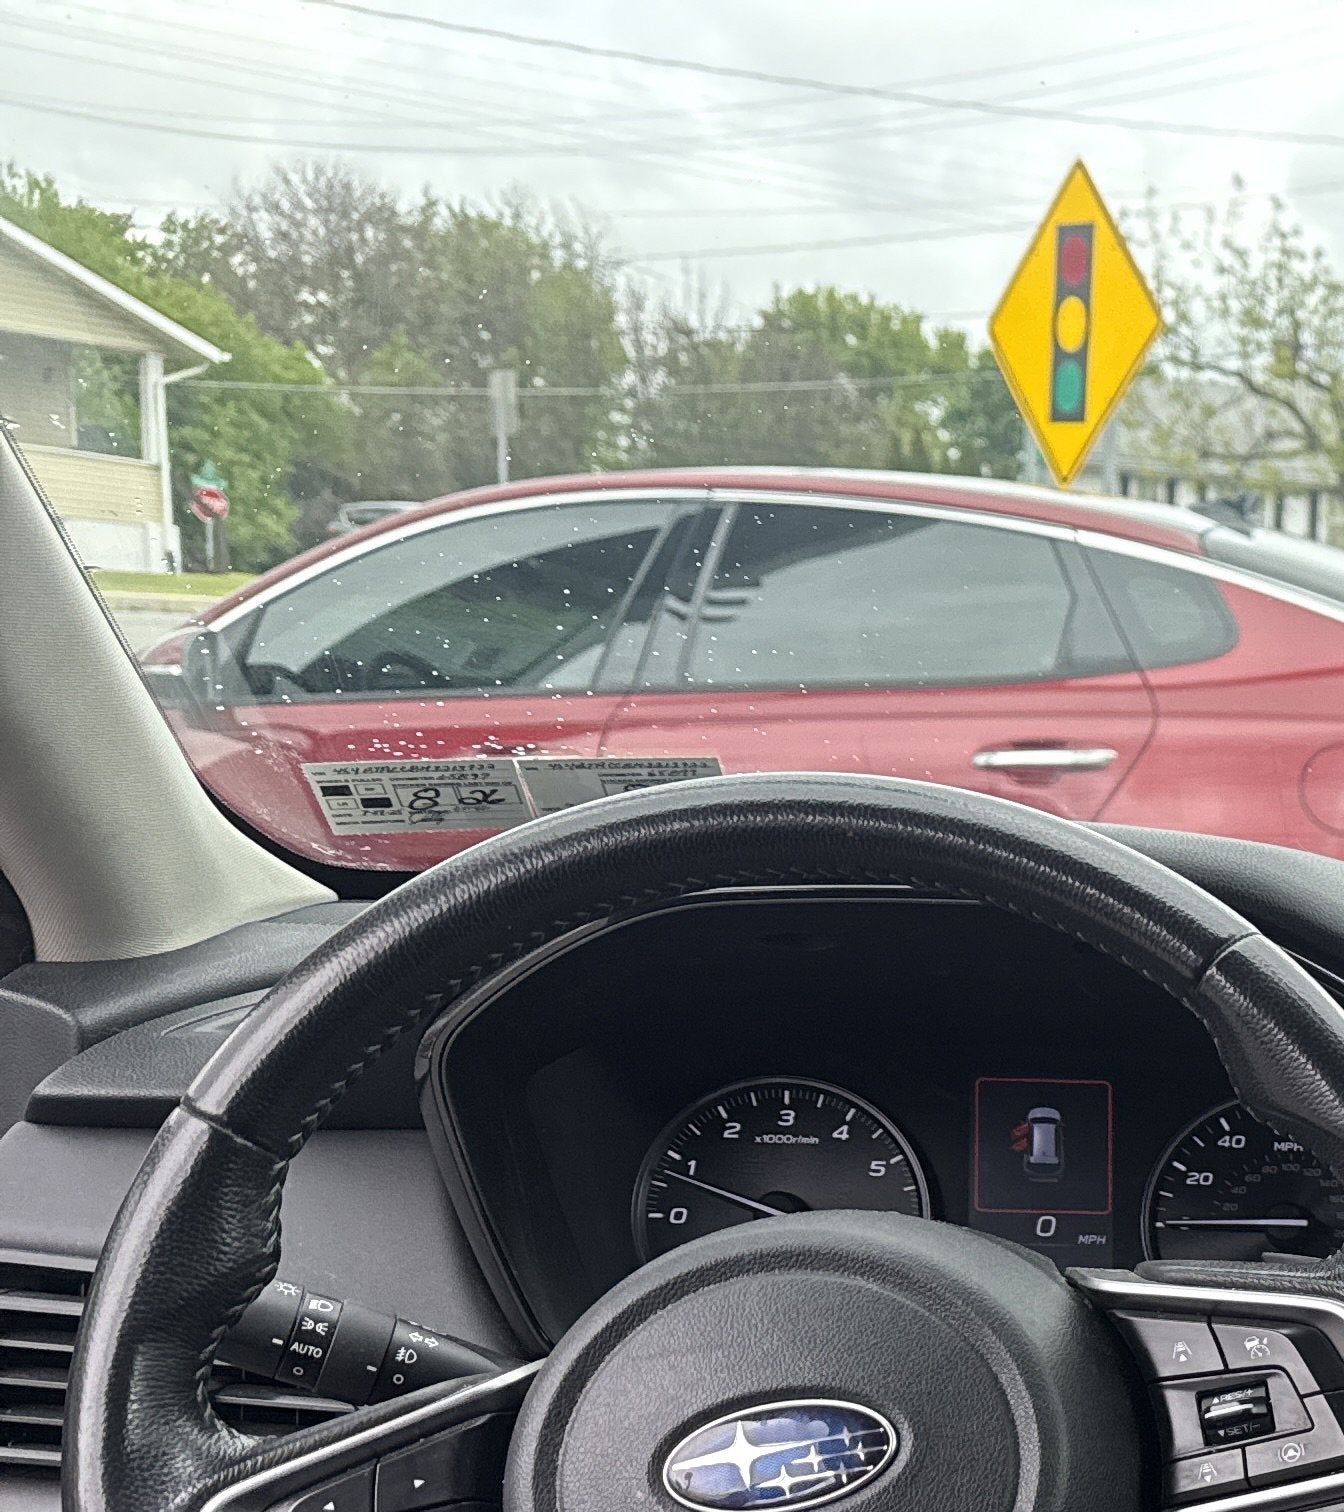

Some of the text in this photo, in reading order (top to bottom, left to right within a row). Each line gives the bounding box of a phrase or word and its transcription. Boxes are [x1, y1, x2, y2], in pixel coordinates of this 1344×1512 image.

[777, 1110, 796, 1127] 3
[723, 1122, 742, 1139] 2
[831, 1125, 850, 1141] 4
[1217, 1135, 1246, 1149] 40
[686, 1160, 696, 1176] 1
[868, 1161, 887, 1177] 5
[1185, 1172, 1214, 1186] 20
[668, 1207, 688, 1224] 0
[1035, 1216, 1058, 1238] 0
[1078, 1234, 1107, 1246] MPH
[290, 1341, 323, 1359] AUTO
